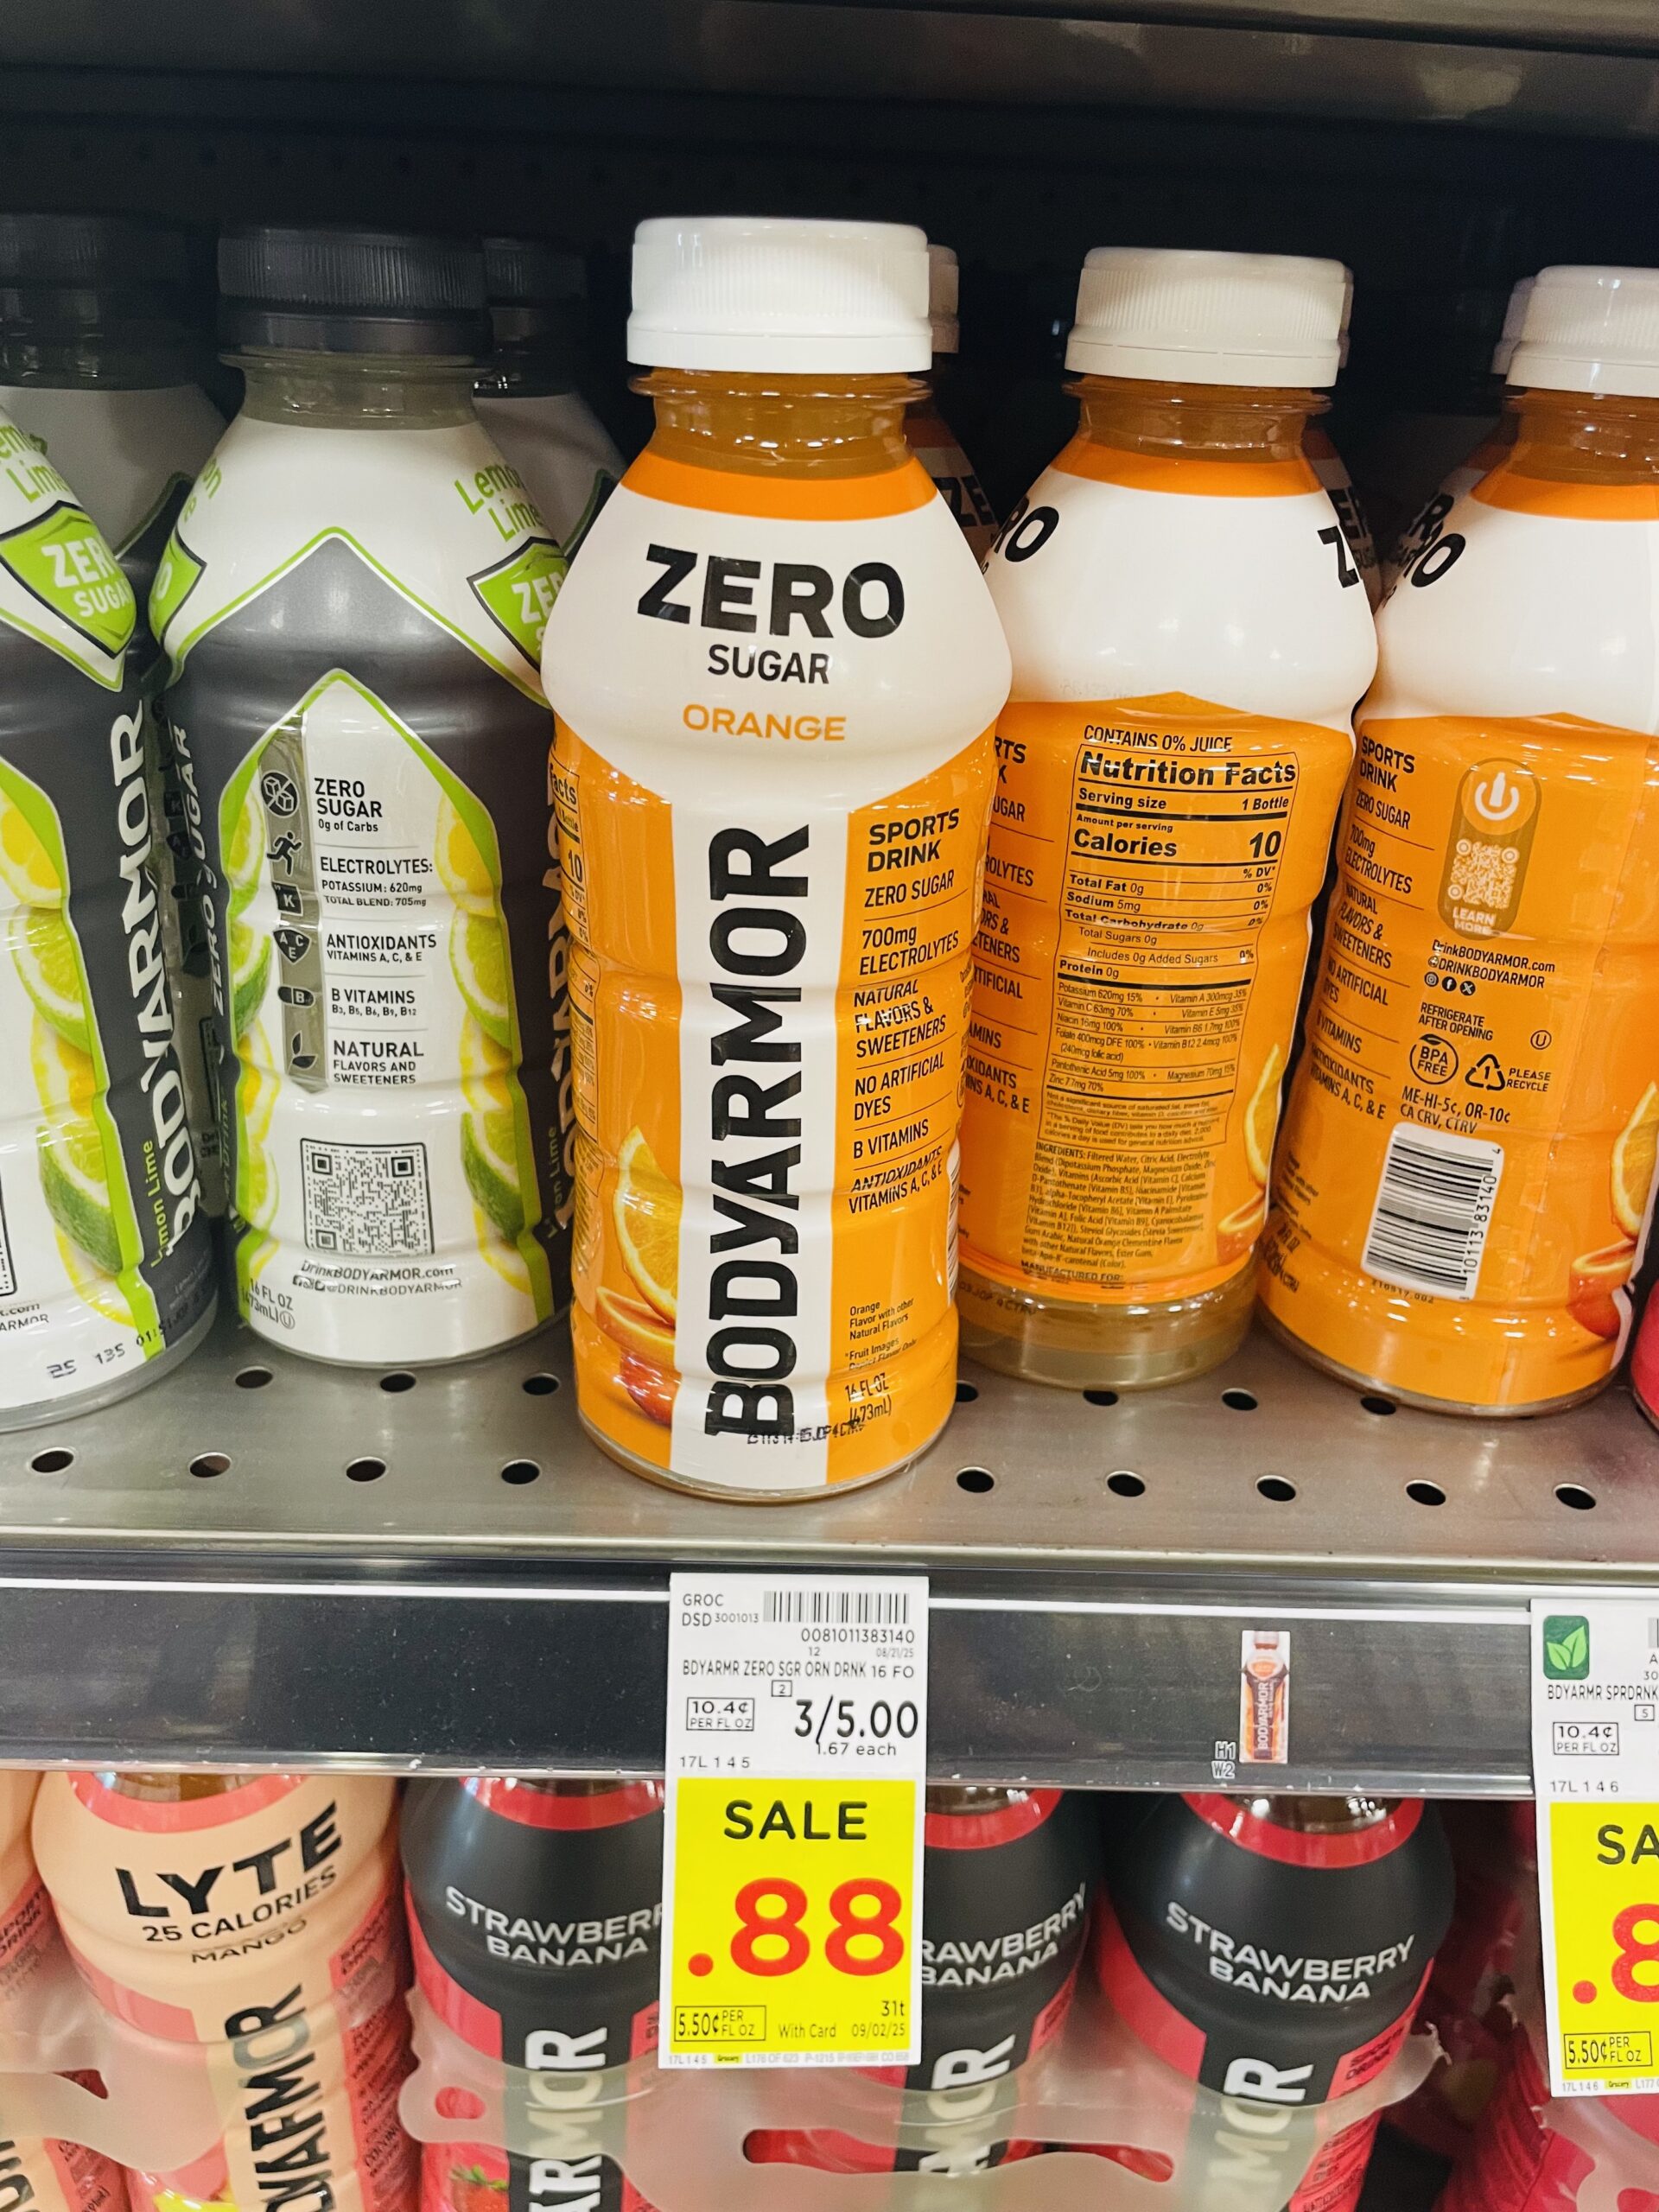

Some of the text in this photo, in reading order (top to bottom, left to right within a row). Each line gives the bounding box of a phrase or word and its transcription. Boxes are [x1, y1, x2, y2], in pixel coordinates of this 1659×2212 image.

[41, 537, 115, 588] ZER
[73, 575, 130, 617] SUGA
[637, 543, 905, 639] ZERO
[708, 644, 830, 684] SUGAR
[683, 704, 847, 741] ORANGE
[1084, 725, 1232, 753] CONTAINS 0% JUICE
[1361, 735, 1415, 774] SPORTS
[1081, 751, 1296, 785] Nutrition Facts
[1359, 759, 1398, 793] DRINK
[315, 778, 365, 798] ZERO
[1079, 787, 1289, 810] Serving size Bottle
[317, 798, 383, 817] SUGAR
[1356, 788, 1411, 830] ZERO SUGAR
[318, 819, 378, 831] 0g of Carbs
[869, 808, 960, 845] SPORTS
[1077, 814, 1173, 833] Amount per serving
[1074, 828, 1281, 858] Calories 10
[321, 856, 433, 874] ELECTROLYTES:
[568, 849, 583, 883] 10
[868, 839, 942, 873] DRINK
[1344, 846, 1413, 894] ELECTROLYTES
[390, 882, 423, 893] 620mg
[864, 869, 955, 907] ZERO SUGAR
[1070, 874, 1144, 895] Total Fat 0g
[323, 895, 426, 906] TOTAL BLEND: 705mg
[1067, 892, 1141, 913] Sodium 5mg
[1065, 909, 1096, 922] Total
[1452, 906, 1497, 926] LEARN
[327, 934, 436, 950] ANTIOXIDANTS
[862, 926, 917, 950] 700mg
[1078, 926, 1157, 946] Total Sugars 0g
[327, 950, 377, 962] VITAMINS
[860, 930, 959, 976] ELECTROLYTES
[1088, 947, 1181, 964] Includes 0g Added
[1432, 938, 1555, 973] DrinkBODYARMOR.com
[1060, 959, 1119, 979] Protein 0g
[332, 988, 416, 1004] B VITAMINS
[854, 979, 918, 1007] NATURAL
[855, 996, 934, 1033] FLAVORS &
[1421, 1002, 1485, 1027] REFRIGERATE
[856, 1014, 947, 1058] SWEETENERS
[1418, 1014, 1494, 1041] AFTER OPENING
[334, 1040, 424, 1057] NATURAL
[1421, 1046, 1448, 1065] BPA
[334, 1059, 416, 1071] FLAVORS AND
[855, 1051, 944, 1096] NO ARTIFICIAL
[1418, 1059, 1448, 1077] FREE
[1509, 1068, 1551, 1081] PLEASE
[334, 1073, 416, 1085] SWEETENERS
[1506, 1079, 1549, 1092] RECYCLE
[854, 1096, 891, 1121] DYES
[704, 823, 810, 1437] BODYARMOR
[1417, 1109, 1478, 1135] CRV, CTRV
[853, 1118, 929, 1160] B VITAMINS
[851, 1146, 942, 1193] ANTIOXIDANTS
[849, 1181, 908, 1214] VITAMINS
[1474, 1175, 1497, 1223] 83140
[250, 1279, 294, 1311] 16 FL OZ
[849, 1300, 880, 1317] Orange
[849, 1313, 876, 1329] Flavor
[849, 1313, 909, 1341] Natural Flavors
[861, 1379, 873, 1398] FL
[683, 1593, 724, 1606] GROC
[682, 1612, 759, 1626] DSD 3001013
[801, 1628, 914, 1643] 0081011383140
[683, 1660, 914, 1678] BDYARMR ZERO SGR ORN DRNK 16 FO
[1548, 1685, 1602, 1700] BDYARMR
[690, 1718, 752, 1728] PER FL OZ
[794, 1694, 918, 1745] 3/5.00
[817, 1743, 896, 1756] 1.67 each
[1557, 1743, 1617, 1752] PER FL OZ
[680, 1756, 708, 1768] 17L
[1550, 1781, 1578, 1792] 17L
[724, 1799, 868, 1840] SALE
[1597, 1824, 1659, 1865] SA
[116, 1800, 341, 1917] LYTE
[144, 1865, 337, 1942] 25 CALORIES
[444, 1885, 662, 1945] STRAWBER
[688, 1877, 905, 1977] .88
[921, 1882, 1086, 1964] RAWBERRY
[191, 1919, 308, 1963] MANGO
[486, 1936, 649, 1966] BANANA
[1166, 1901, 1415, 1983] STRAWBERRY
[1573, 1903, 1659, 2004] .8
[921, 1942, 1058, 1986] BANANA
[1209, 1956, 1371, 2003] BANANA
[722, 2010, 743, 2022] PER
[881, 2000, 905, 2017] 31t
[722, 2024, 754, 2036] FL OZ
[779, 2023, 906, 2039] With Card 09/02/25
[1610, 2037, 1630, 2048] PER
[1610, 2050, 1642, 2063] FL OZ
